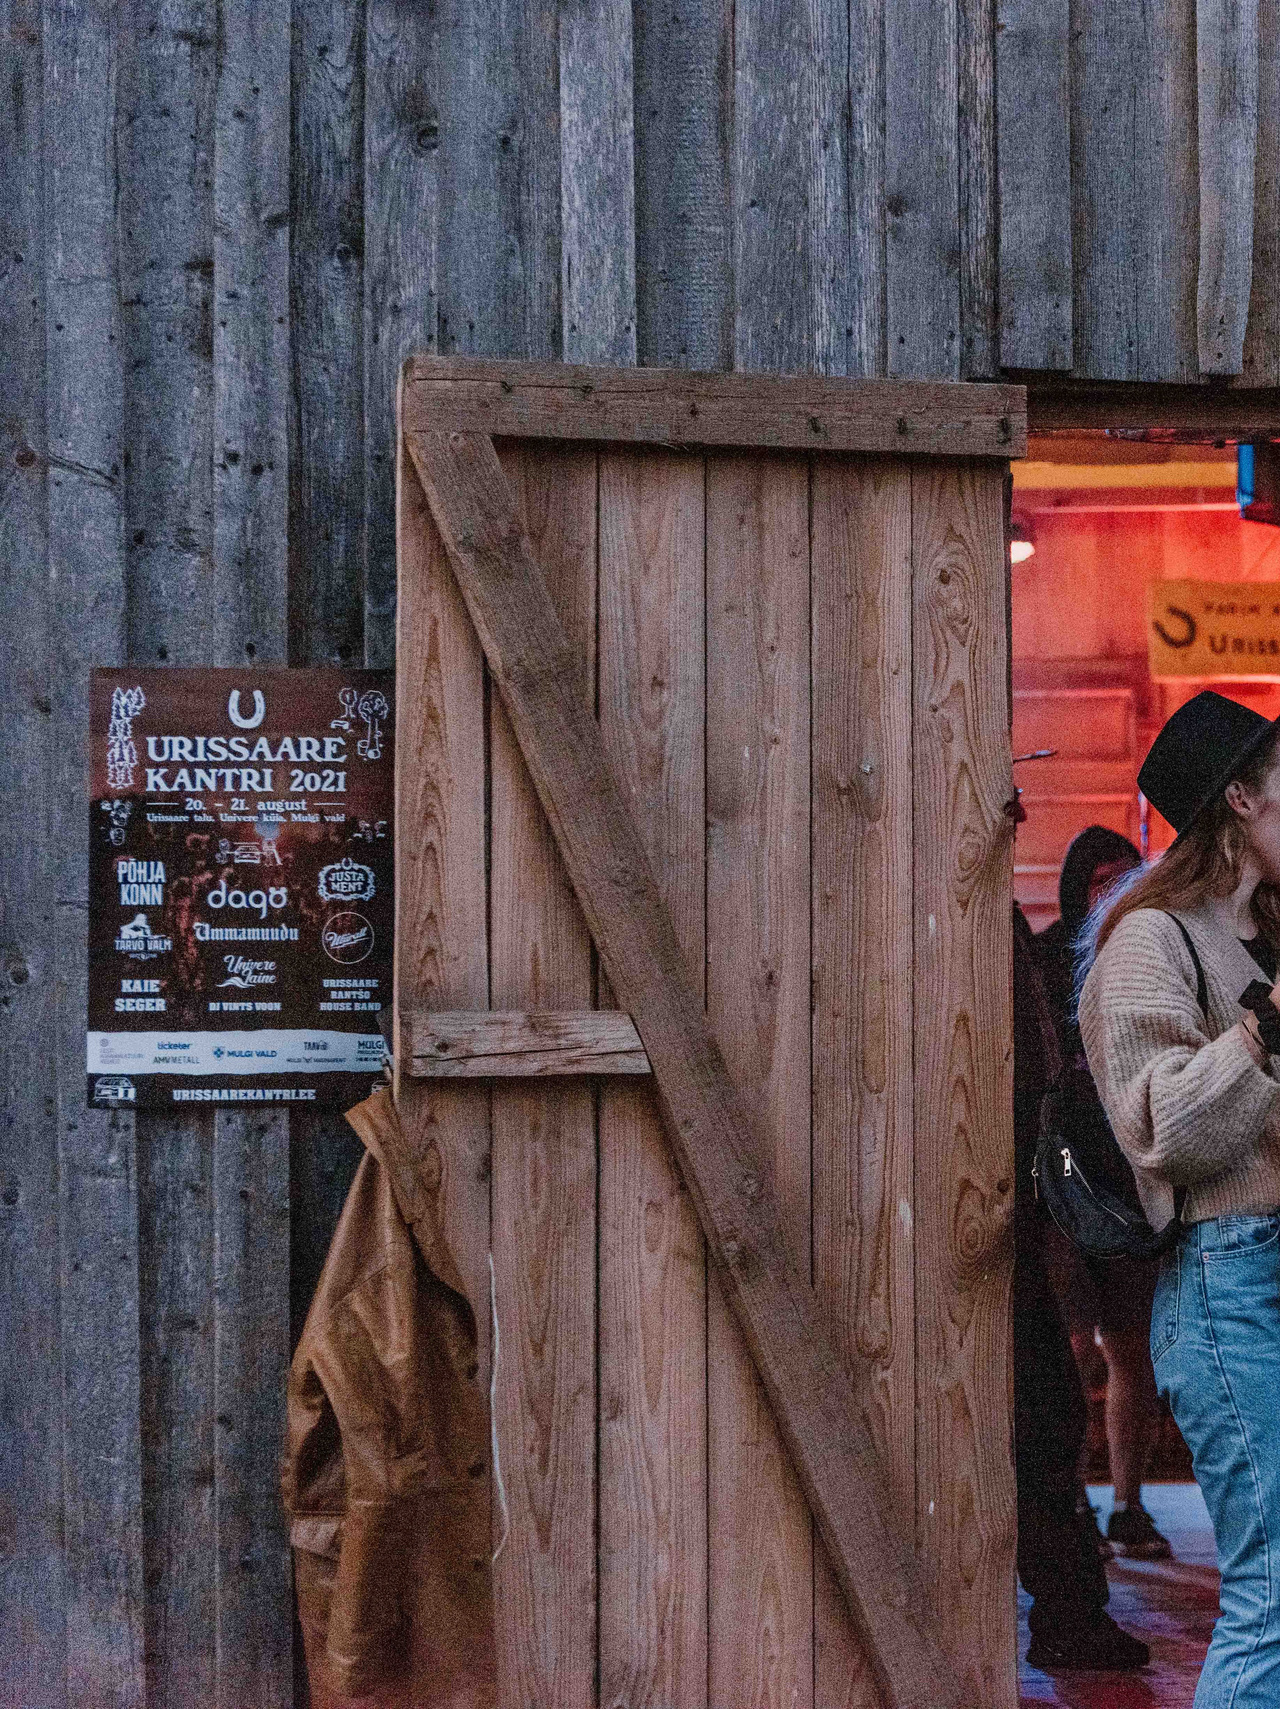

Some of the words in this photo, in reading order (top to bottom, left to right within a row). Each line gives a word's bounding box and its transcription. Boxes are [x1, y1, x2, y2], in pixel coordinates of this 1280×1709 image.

[145, 736, 347, 762] URISSAARE
[145, 768, 274, 792] KANTRI
[289, 768, 347, 792] 2021
[185, 798, 207, 811] 20.
[230, 798, 250, 811] 21.
[257, 799, 307, 813] august
[146, 813, 189, 822] Urissaare
[220, 813, 259, 822] Univere
[291, 813, 320, 823] Mulgi
[324, 813, 346, 822] vald
[117, 858, 166, 883] PÕHJA
[328, 872, 366, 883] JUSTA
[331, 881, 363, 892] MENT
[120, 884, 163, 906] KONN
[114, 939, 144, 951] TARVO
[146, 939, 173, 951] VALM
[223, 954, 277, 975] Univere
[121, 979, 161, 993] KAIE
[322, 978, 379, 988] URISSAARE
[115, 998, 167, 1012] SEGER
[208, 1002, 221, 1011] DJ
[222, 1002, 252, 1011] VINTS
[255, 1002, 282, 1011] VOON
[319, 1002, 352, 1011] HOUSE
[353, 1002, 382, 1011] BAND
[157, 1041, 191, 1051] ticketer
[357, 1040, 385, 1050] MULGI
